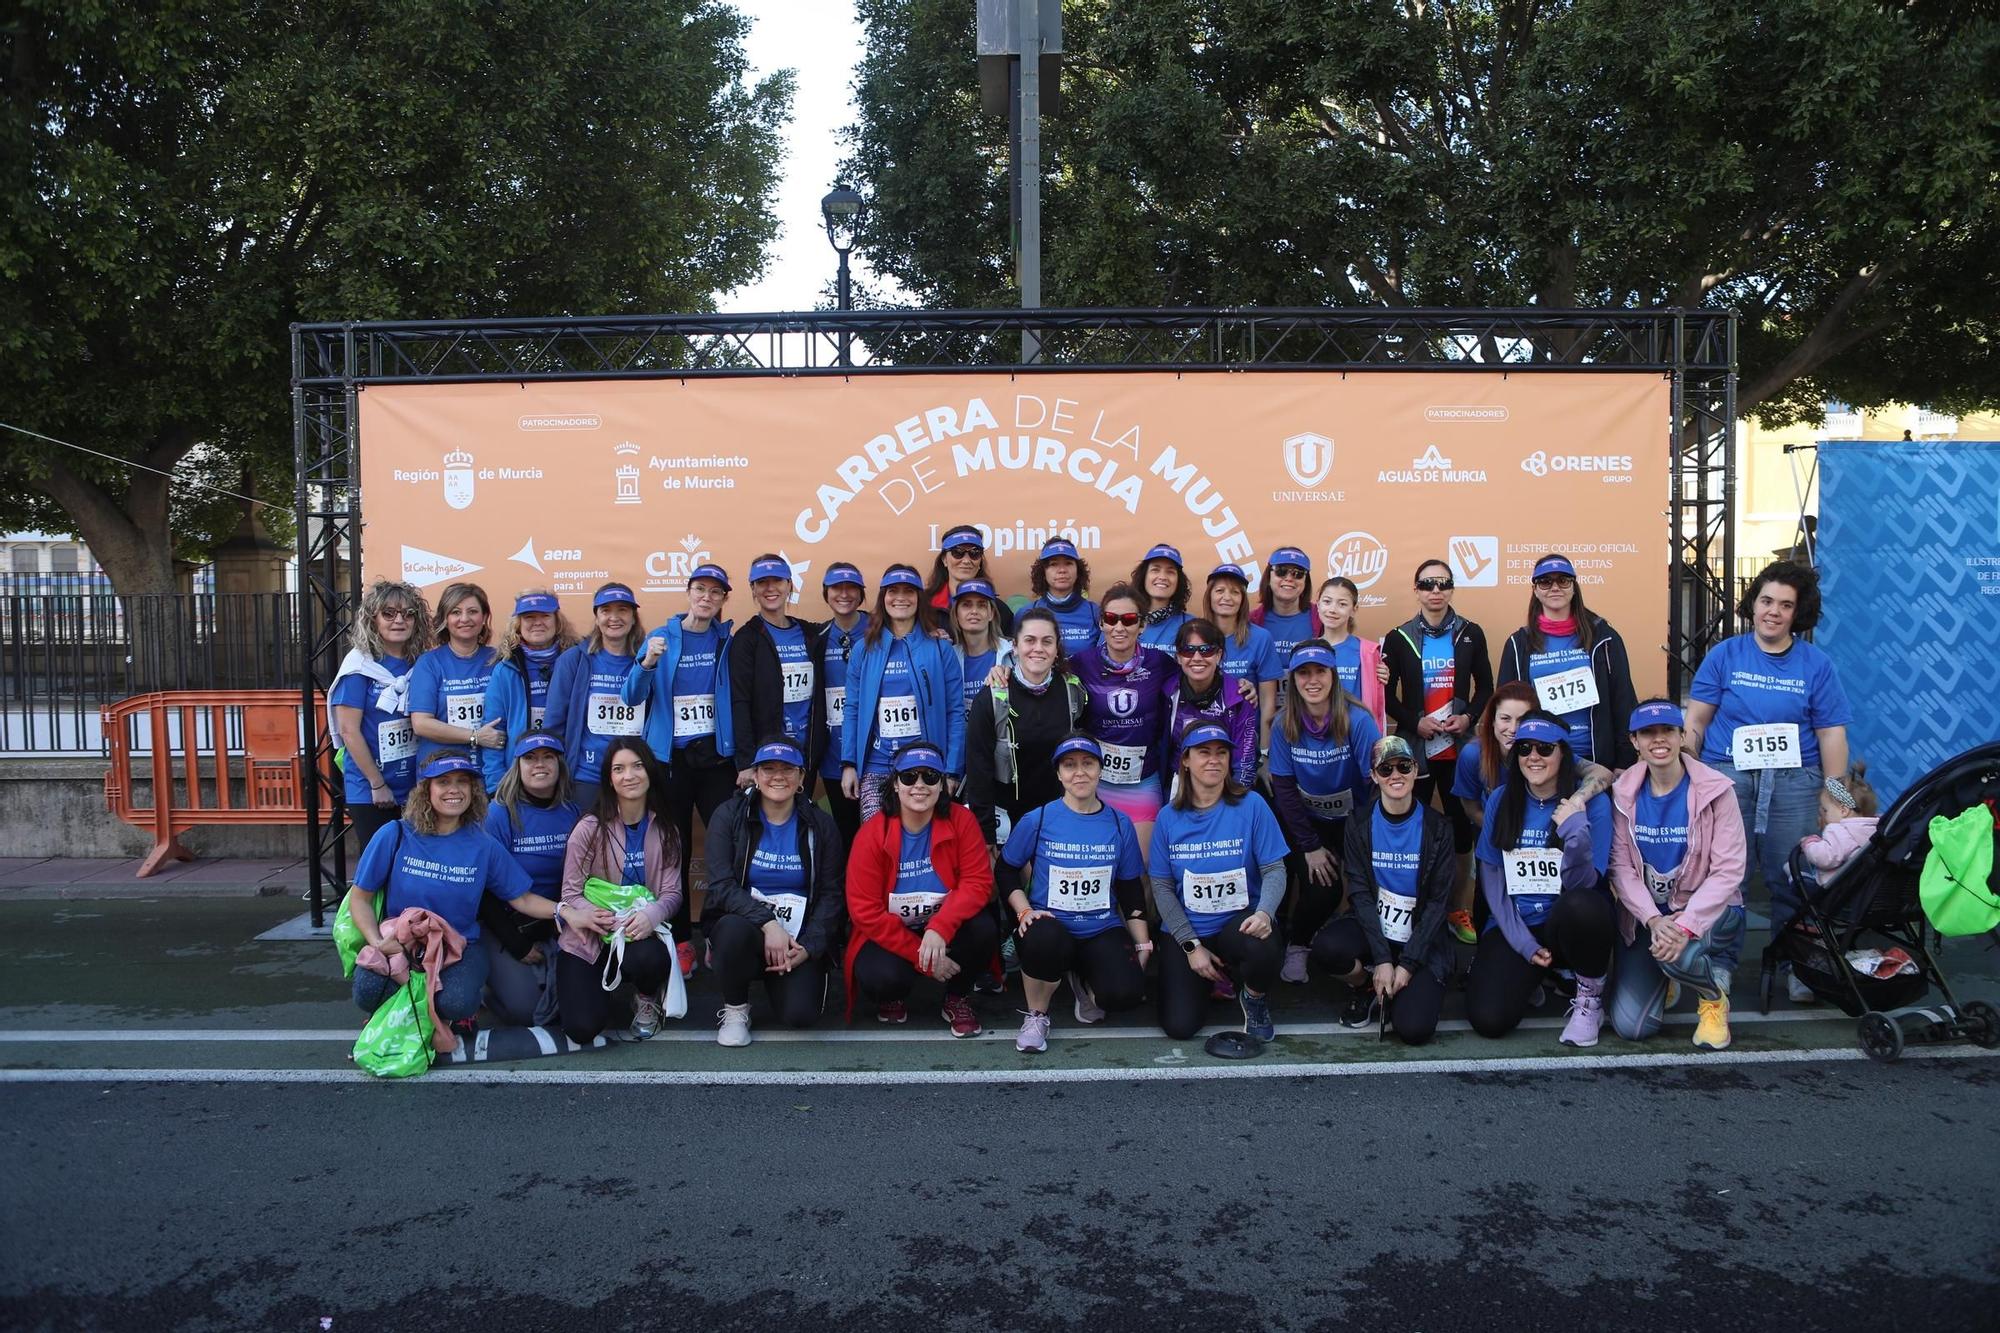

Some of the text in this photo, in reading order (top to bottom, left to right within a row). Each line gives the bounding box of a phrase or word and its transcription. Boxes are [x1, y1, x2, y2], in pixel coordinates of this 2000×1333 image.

[1428, 409, 1505, 418] PATROCINADORES
[522, 418, 598, 427] PATROCINADORES
[649, 454, 749, 471] Ayuntamiento
[795, 398, 999, 544] CARRERA
[1015, 394, 1079, 435] DE
[1089, 409, 1140, 462] LA
[1550, 455, 1633, 472] ORENES
[394, 466, 543, 484] Región de Murcia
[878, 435, 1143, 516] DE MURCIA
[1377, 470, 1488, 483] AGUAS DE MURCIA
[1602, 475, 1633, 483] GRUPO
[663, 475, 735, 490] de Murcia
[1273, 491, 1345, 502] UNIVERSAE
[1348, 540, 1361, 552] LA
[1506, 543, 1639, 553] ILUSTRE COLEGIO OFICIAL
[543, 546, 582, 561] aena
[413, 563, 434, 573] Corte
[1328, 549, 1388, 577] SALUD
[1506, 559, 1520, 569] DE
[553, 570, 609, 582] aeropuertos
[1977, 571, 1991, 580] DE
[553, 581, 584, 592] para ti
[786, 673, 808, 688] 174
[1767, 676, 1775, 684] ES
[1547, 679, 1586, 701] 3175
[598, 705, 635, 721] 3188
[680, 704, 714, 721] 3178
[884, 706, 917, 723] 3161
[388, 728, 413, 746] 3157
[1743, 736, 1788, 753] 3155
[1308, 800, 1343, 810] 200
[1535, 830, 1544, 838] ES
[1660, 827, 1668, 835] ES
[1081, 844, 1090, 852] ES
[1203, 842, 1211, 850] ES
[1394, 853, 1402, 862] ES
[440, 864, 448, 873] ES
[1516, 860, 1558, 877] 3196
[1059, 879, 1101, 896] 3193
[1193, 882, 1236, 899] 3173
[1377, 900, 1412, 926] 3177
